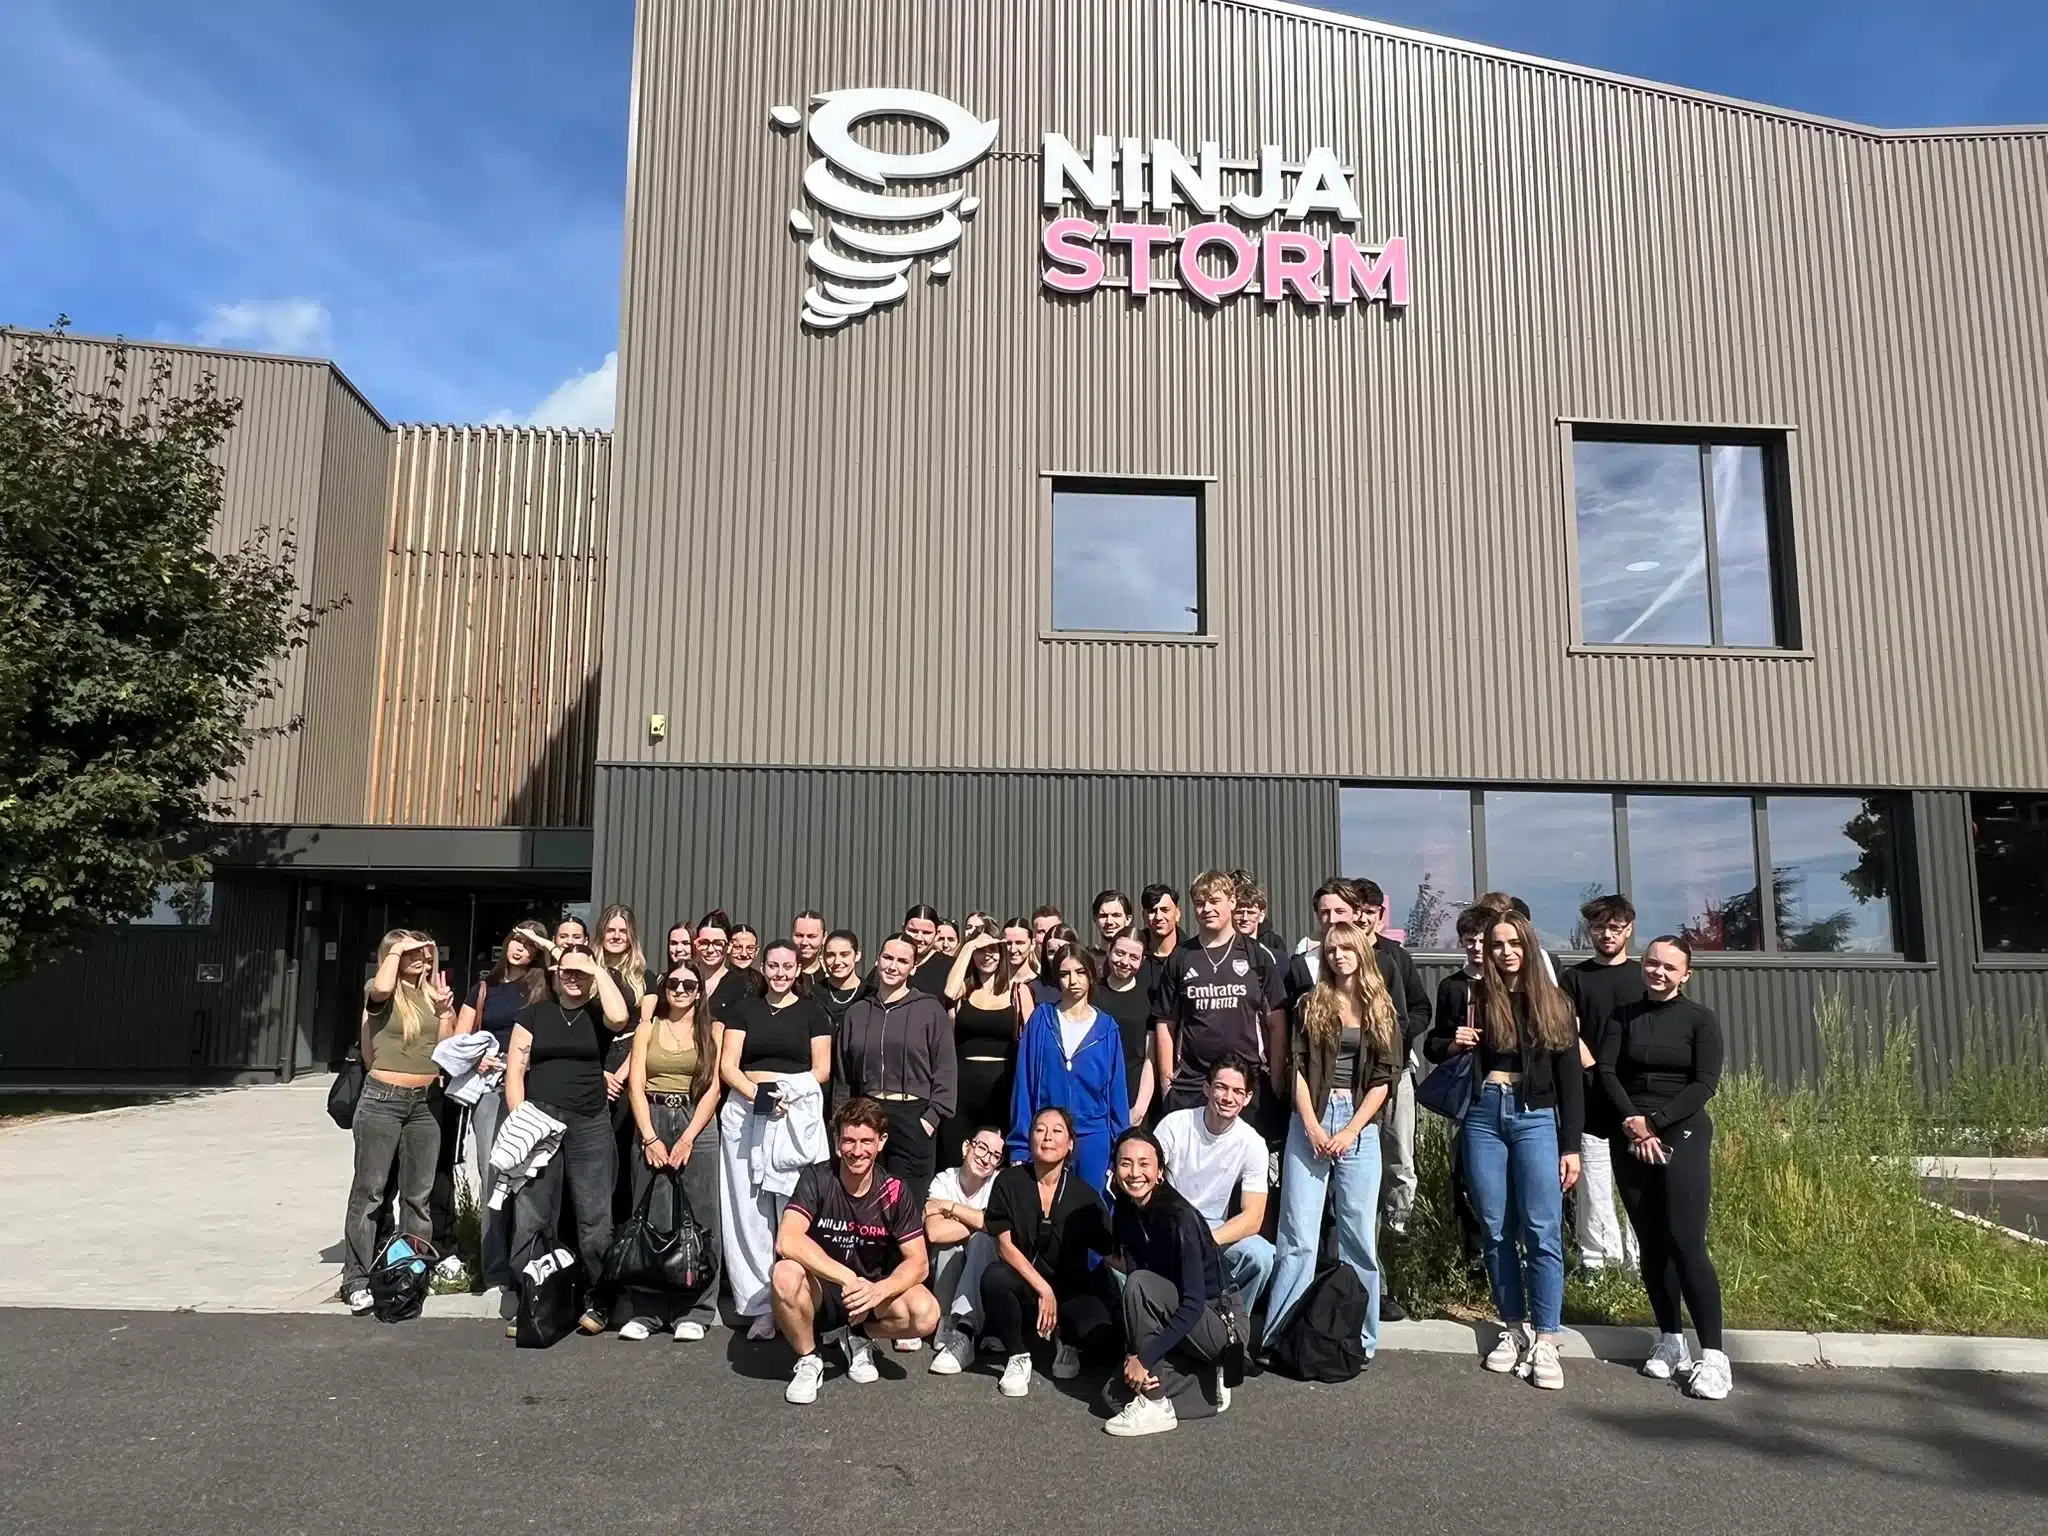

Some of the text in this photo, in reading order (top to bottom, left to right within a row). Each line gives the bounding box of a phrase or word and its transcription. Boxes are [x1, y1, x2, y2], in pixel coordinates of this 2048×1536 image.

[1043, 131, 1362, 222] NINJA
[1042, 216, 1409, 309] STORM
[1187, 983, 1247, 998] Emirates
[1196, 999, 1209, 1010] FLY
[817, 1217, 886, 1236] NINJASORM
